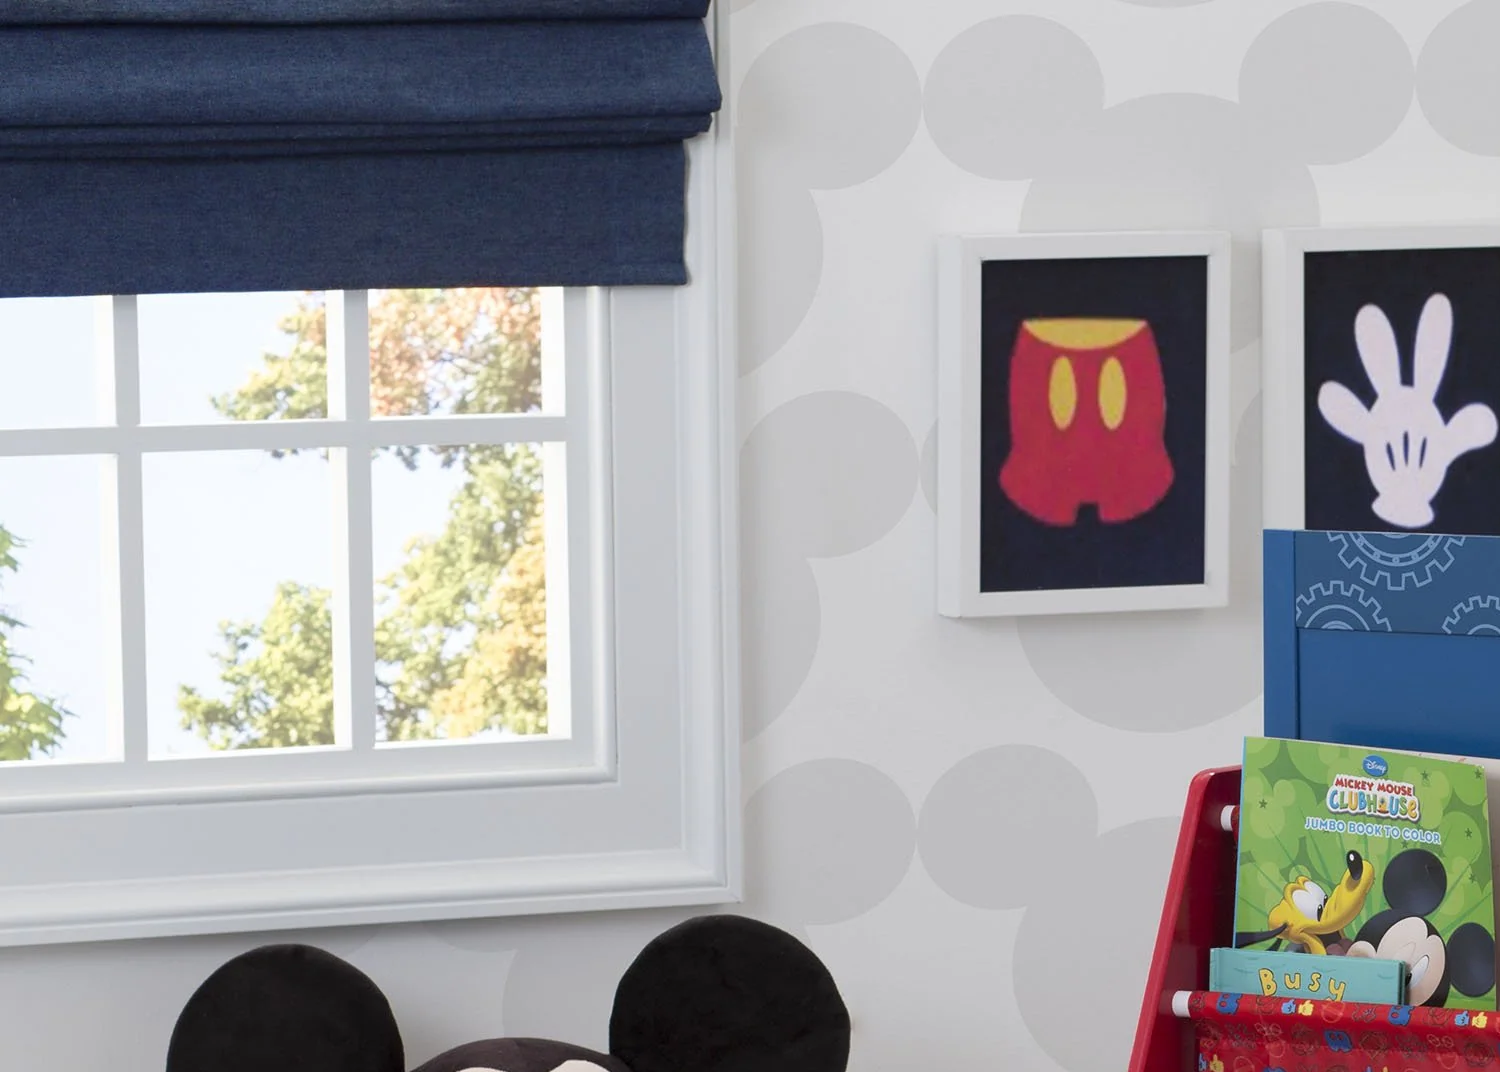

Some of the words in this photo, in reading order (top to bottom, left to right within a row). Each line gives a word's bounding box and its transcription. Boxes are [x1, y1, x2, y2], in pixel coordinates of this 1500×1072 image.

[1364, 759, 1386, 774] Disney
[1335, 778, 1374, 791] MICKEY
[1377, 783, 1412, 796] MOUSE
[1305, 817, 1345, 831] JUMBO
[1348, 822, 1383, 836] BOOK
[1384, 826, 1400, 839] TO
[1402, 828, 1441, 844] COLOR
[1258, 967, 1345, 1002] Busy
